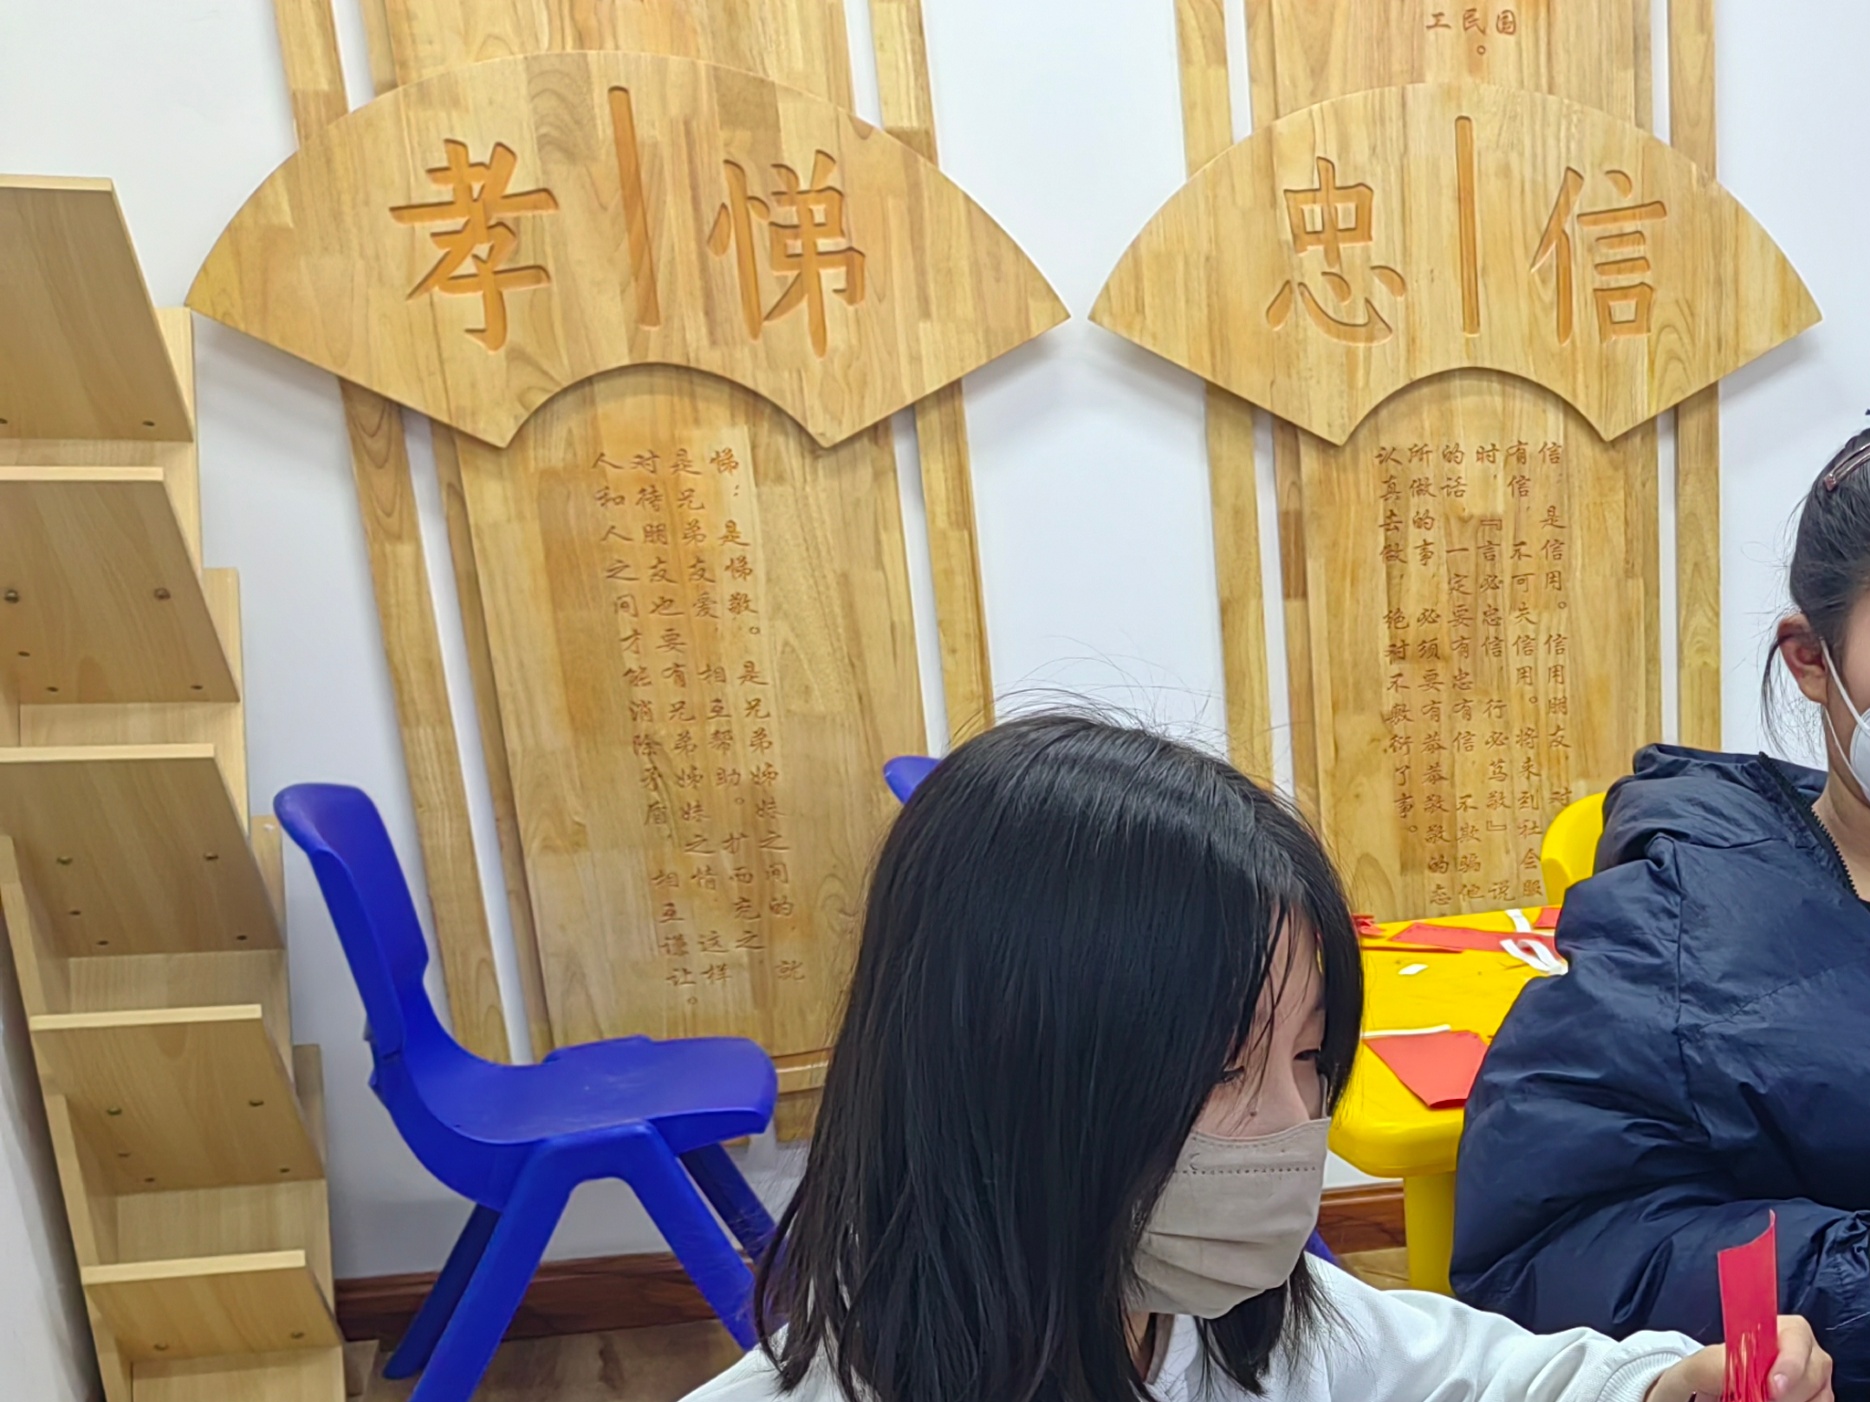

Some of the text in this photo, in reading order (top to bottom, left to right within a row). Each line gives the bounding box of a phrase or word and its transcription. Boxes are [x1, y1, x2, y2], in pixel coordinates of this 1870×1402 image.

[389, 137, 866, 358] 孝 悌
[1266, 156, 1668, 346] 忠 信
